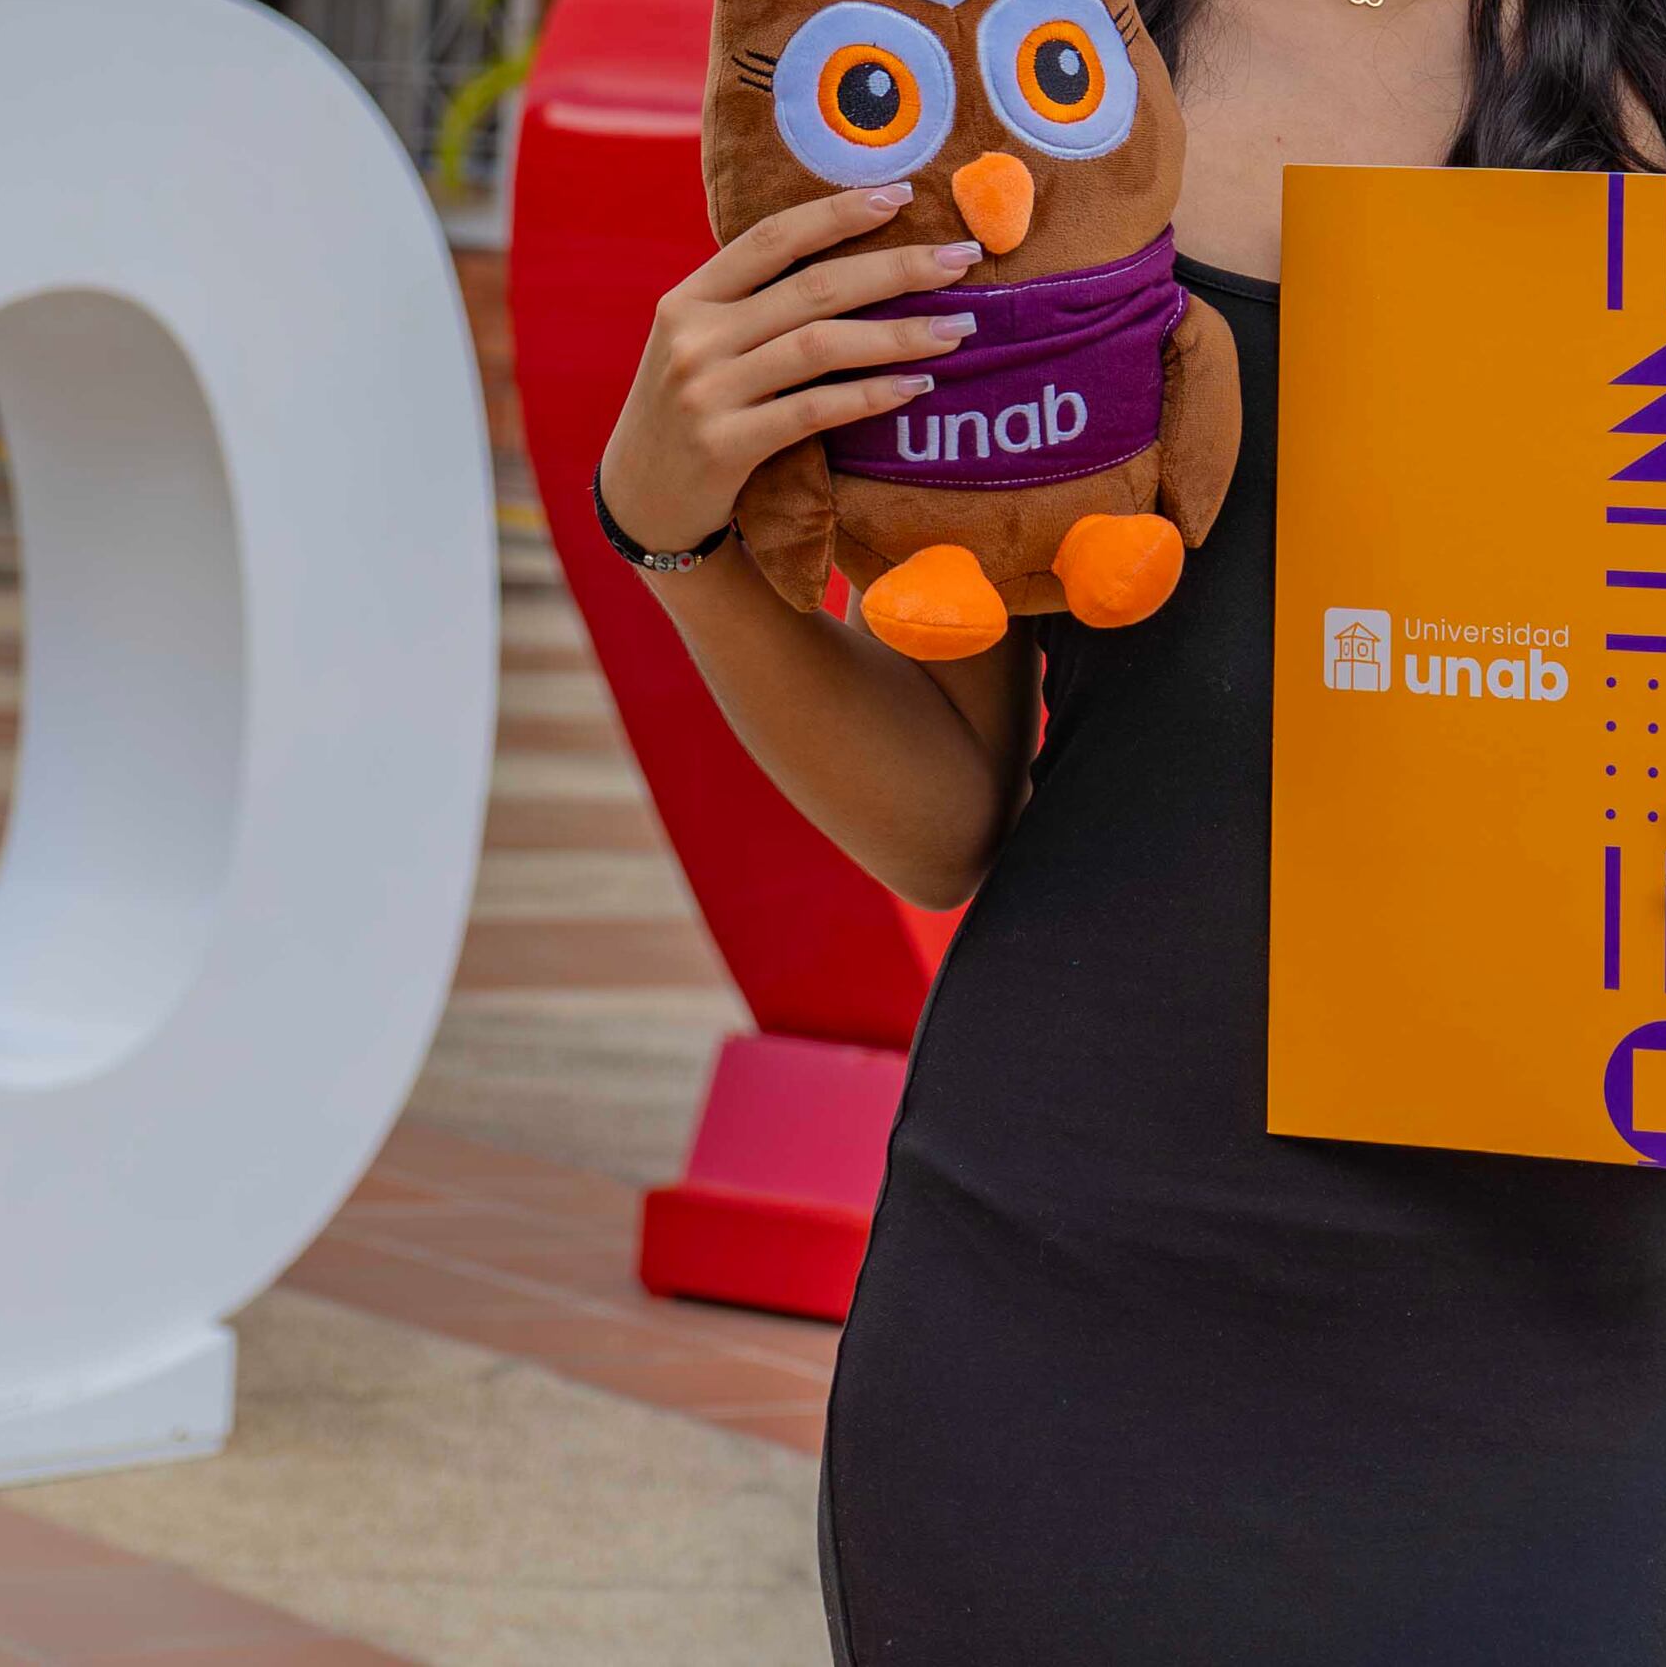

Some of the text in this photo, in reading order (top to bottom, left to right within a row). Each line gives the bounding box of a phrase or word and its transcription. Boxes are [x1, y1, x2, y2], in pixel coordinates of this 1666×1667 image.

[896, 384, 1088, 462] unab
[1404, 618, 1570, 648] Universidad
[1404, 648, 1570, 702] unab
